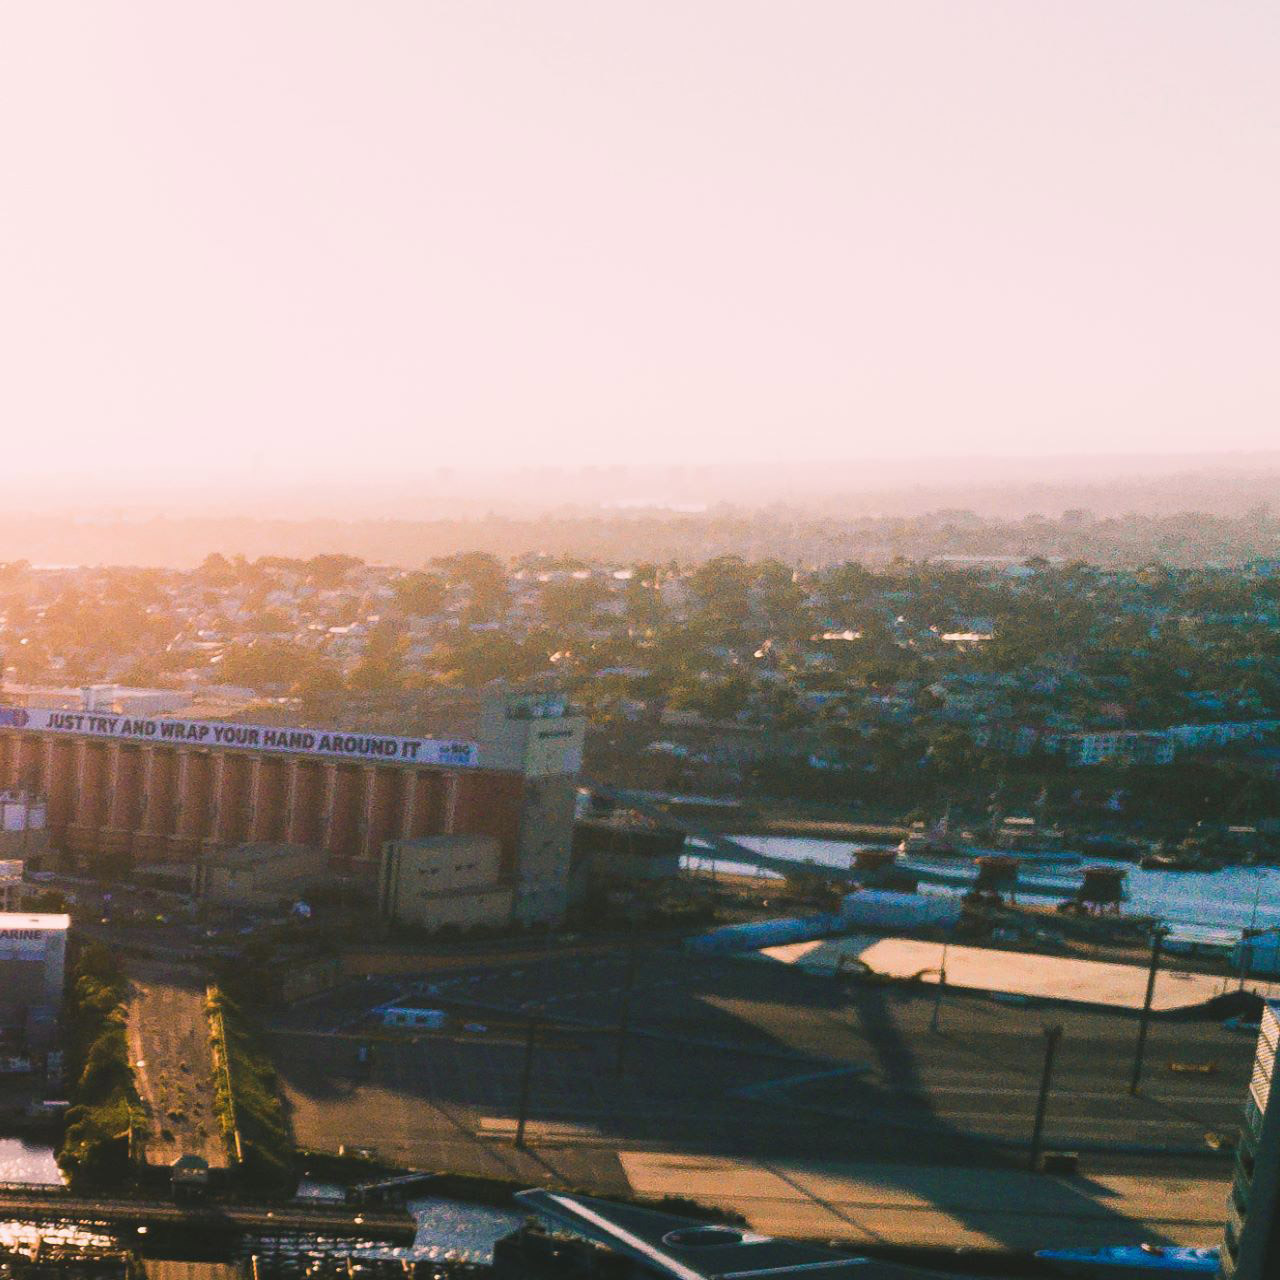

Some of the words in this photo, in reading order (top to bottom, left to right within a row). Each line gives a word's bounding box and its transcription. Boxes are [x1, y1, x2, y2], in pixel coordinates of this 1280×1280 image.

[46, 713, 84, 730] JUST
[88, 715, 118, 733] TRY
[120, 719, 156, 736] AND
[160, 722, 209, 740] WRAP
[213, 726, 258, 744] YOUR
[263, 730, 315, 749] HAND
[318, 735, 397, 756] AROUND
[401, 740, 421, 758] IT
